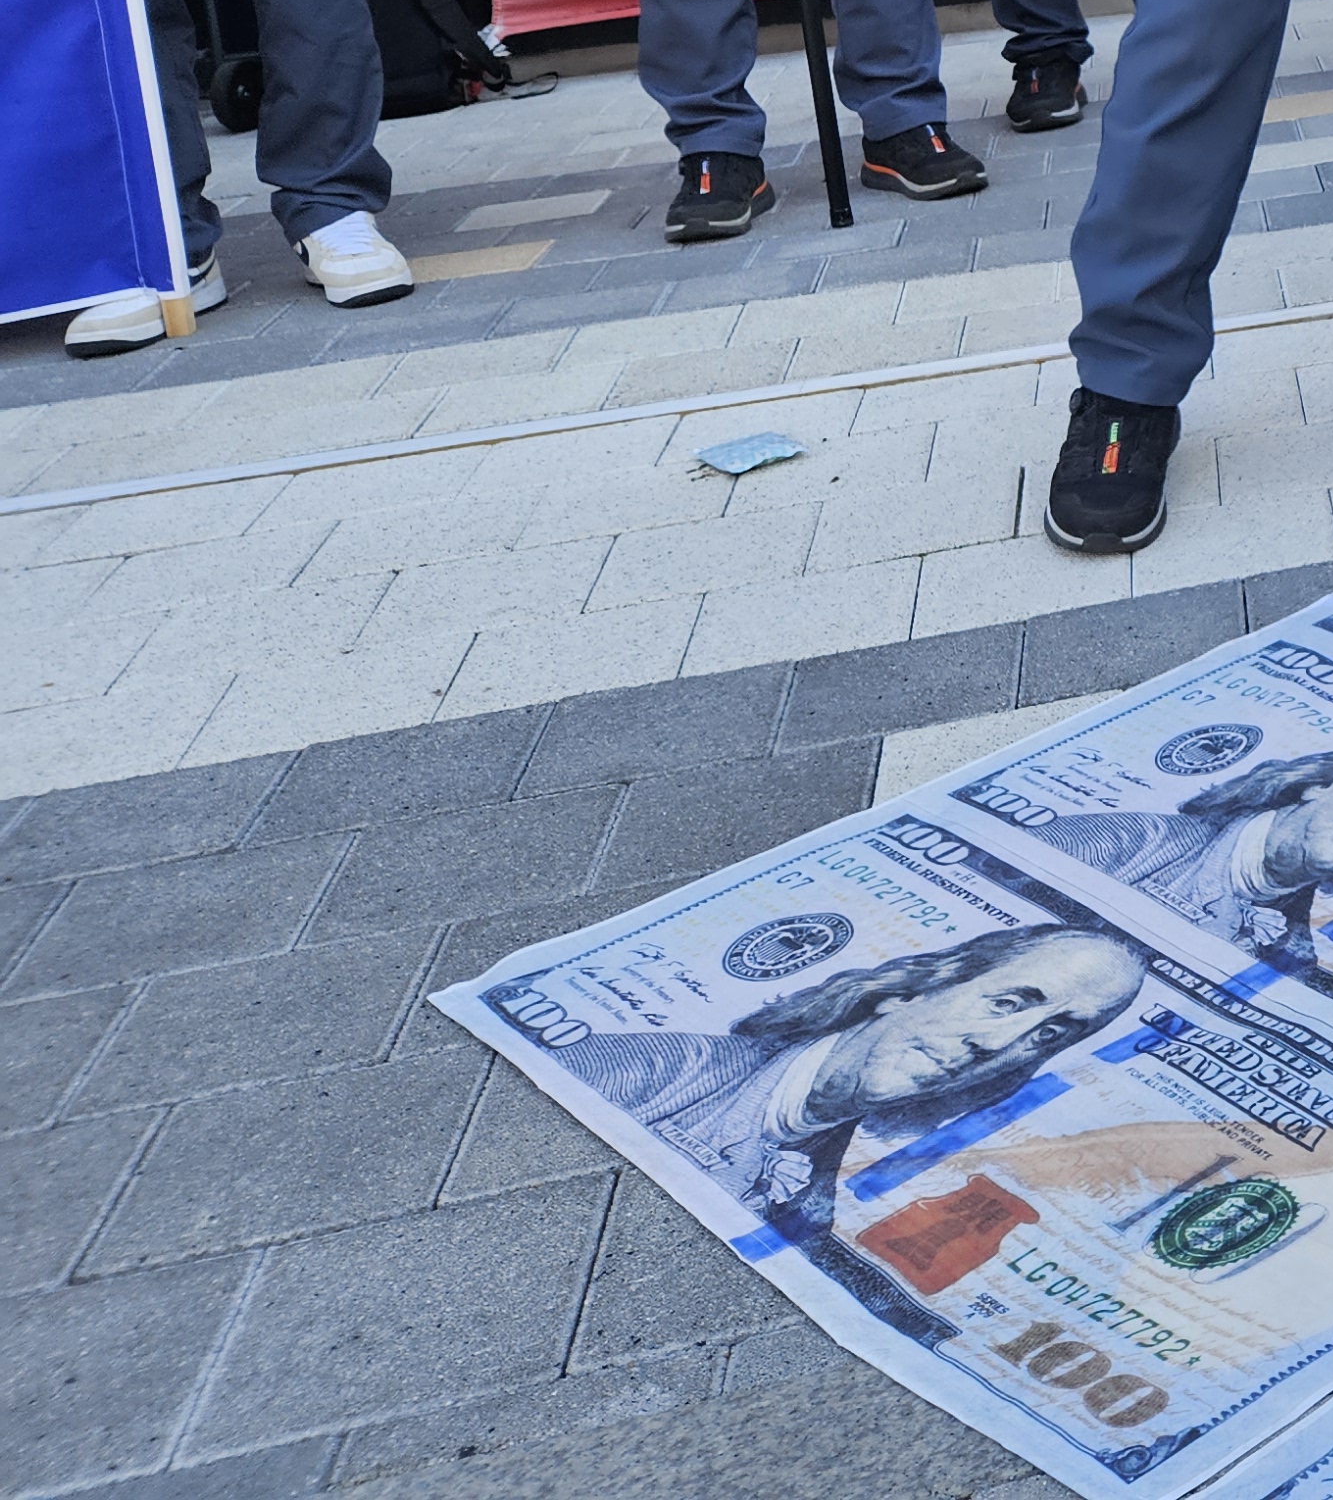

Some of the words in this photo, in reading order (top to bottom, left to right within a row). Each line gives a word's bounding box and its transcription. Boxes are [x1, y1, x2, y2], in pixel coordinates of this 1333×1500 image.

[1180, 689, 1216, 708] G7
[980, 783, 1058, 828] 100
[877, 822, 970, 866] 100
[776, 871, 815, 890] G7
[817, 850, 950, 928] LG04727792
[862, 838, 922, 876] FEDERAL
[918, 868, 981, 907] RESERVE
[979, 899, 1022, 928] NOTE
[1150, 958, 1203, 990] ONE
[511, 986, 593, 1049] 100
[1139, 1003, 1263, 1072] UNITED
[1125, 1067, 1144, 1081] FOR
[1141, 1075, 1160, 1092] ALL
[1187, 1104, 1218, 1130] PUBLIC
[1217, 1123, 1239, 1141] AND
[1236, 1136, 1274, 1162] PRIVATE
[1152, 1071, 1173, 1089] THIS
[1172, 1083, 1197, 1101] NOTE
[1195, 1095, 1204, 1106] IS
[1202, 1100, 1230, 1125] LEGAL
[1227, 1116, 1266, 1144] TENDER
[1167, 1052, 1327, 1152] AMERICA
[968, 1301, 996, 1320] 2009
[975, 1291, 1010, 1316] SERIES
[1006, 1246, 1192, 1362] LG04727792
[986, 1320, 1170, 1429] 100
